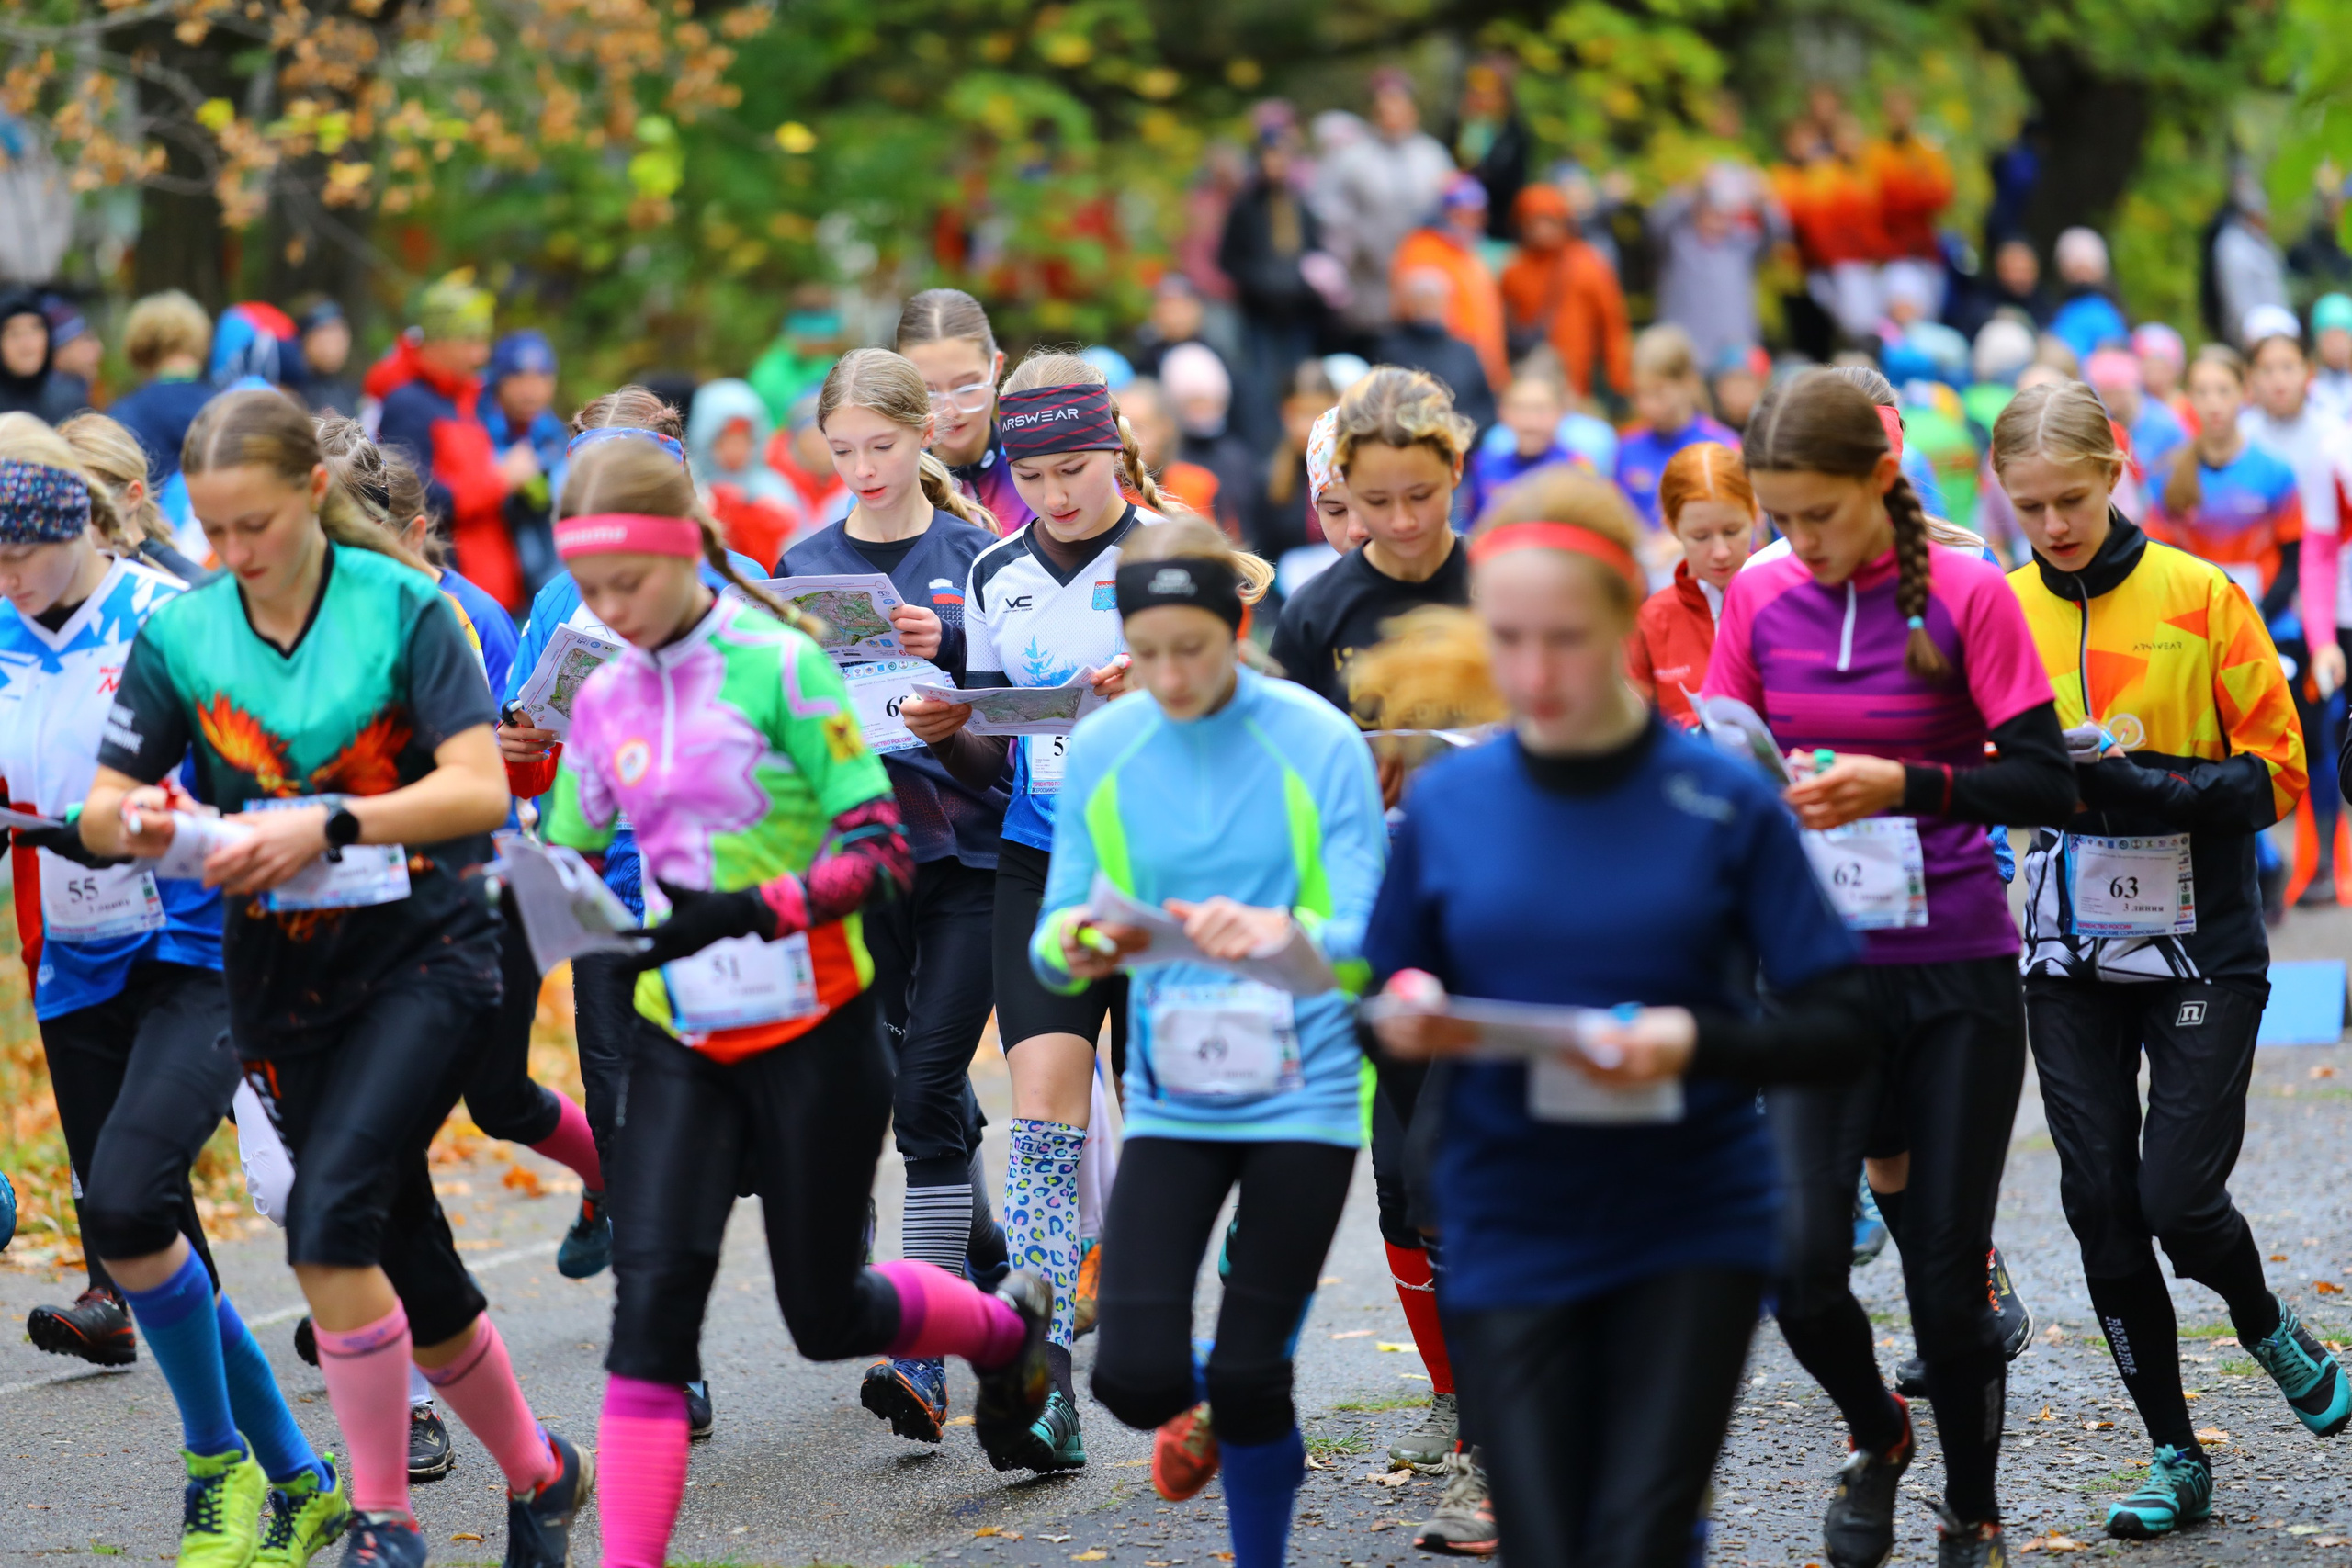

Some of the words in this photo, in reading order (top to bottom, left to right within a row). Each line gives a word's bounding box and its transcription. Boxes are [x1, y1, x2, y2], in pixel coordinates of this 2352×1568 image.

[1001, 408, 1080, 433] ARSWEAR
[1832, 862, 1863, 888] 62
[2109, 875, 2140, 899] 63
[67, 876, 99, 904] 55
